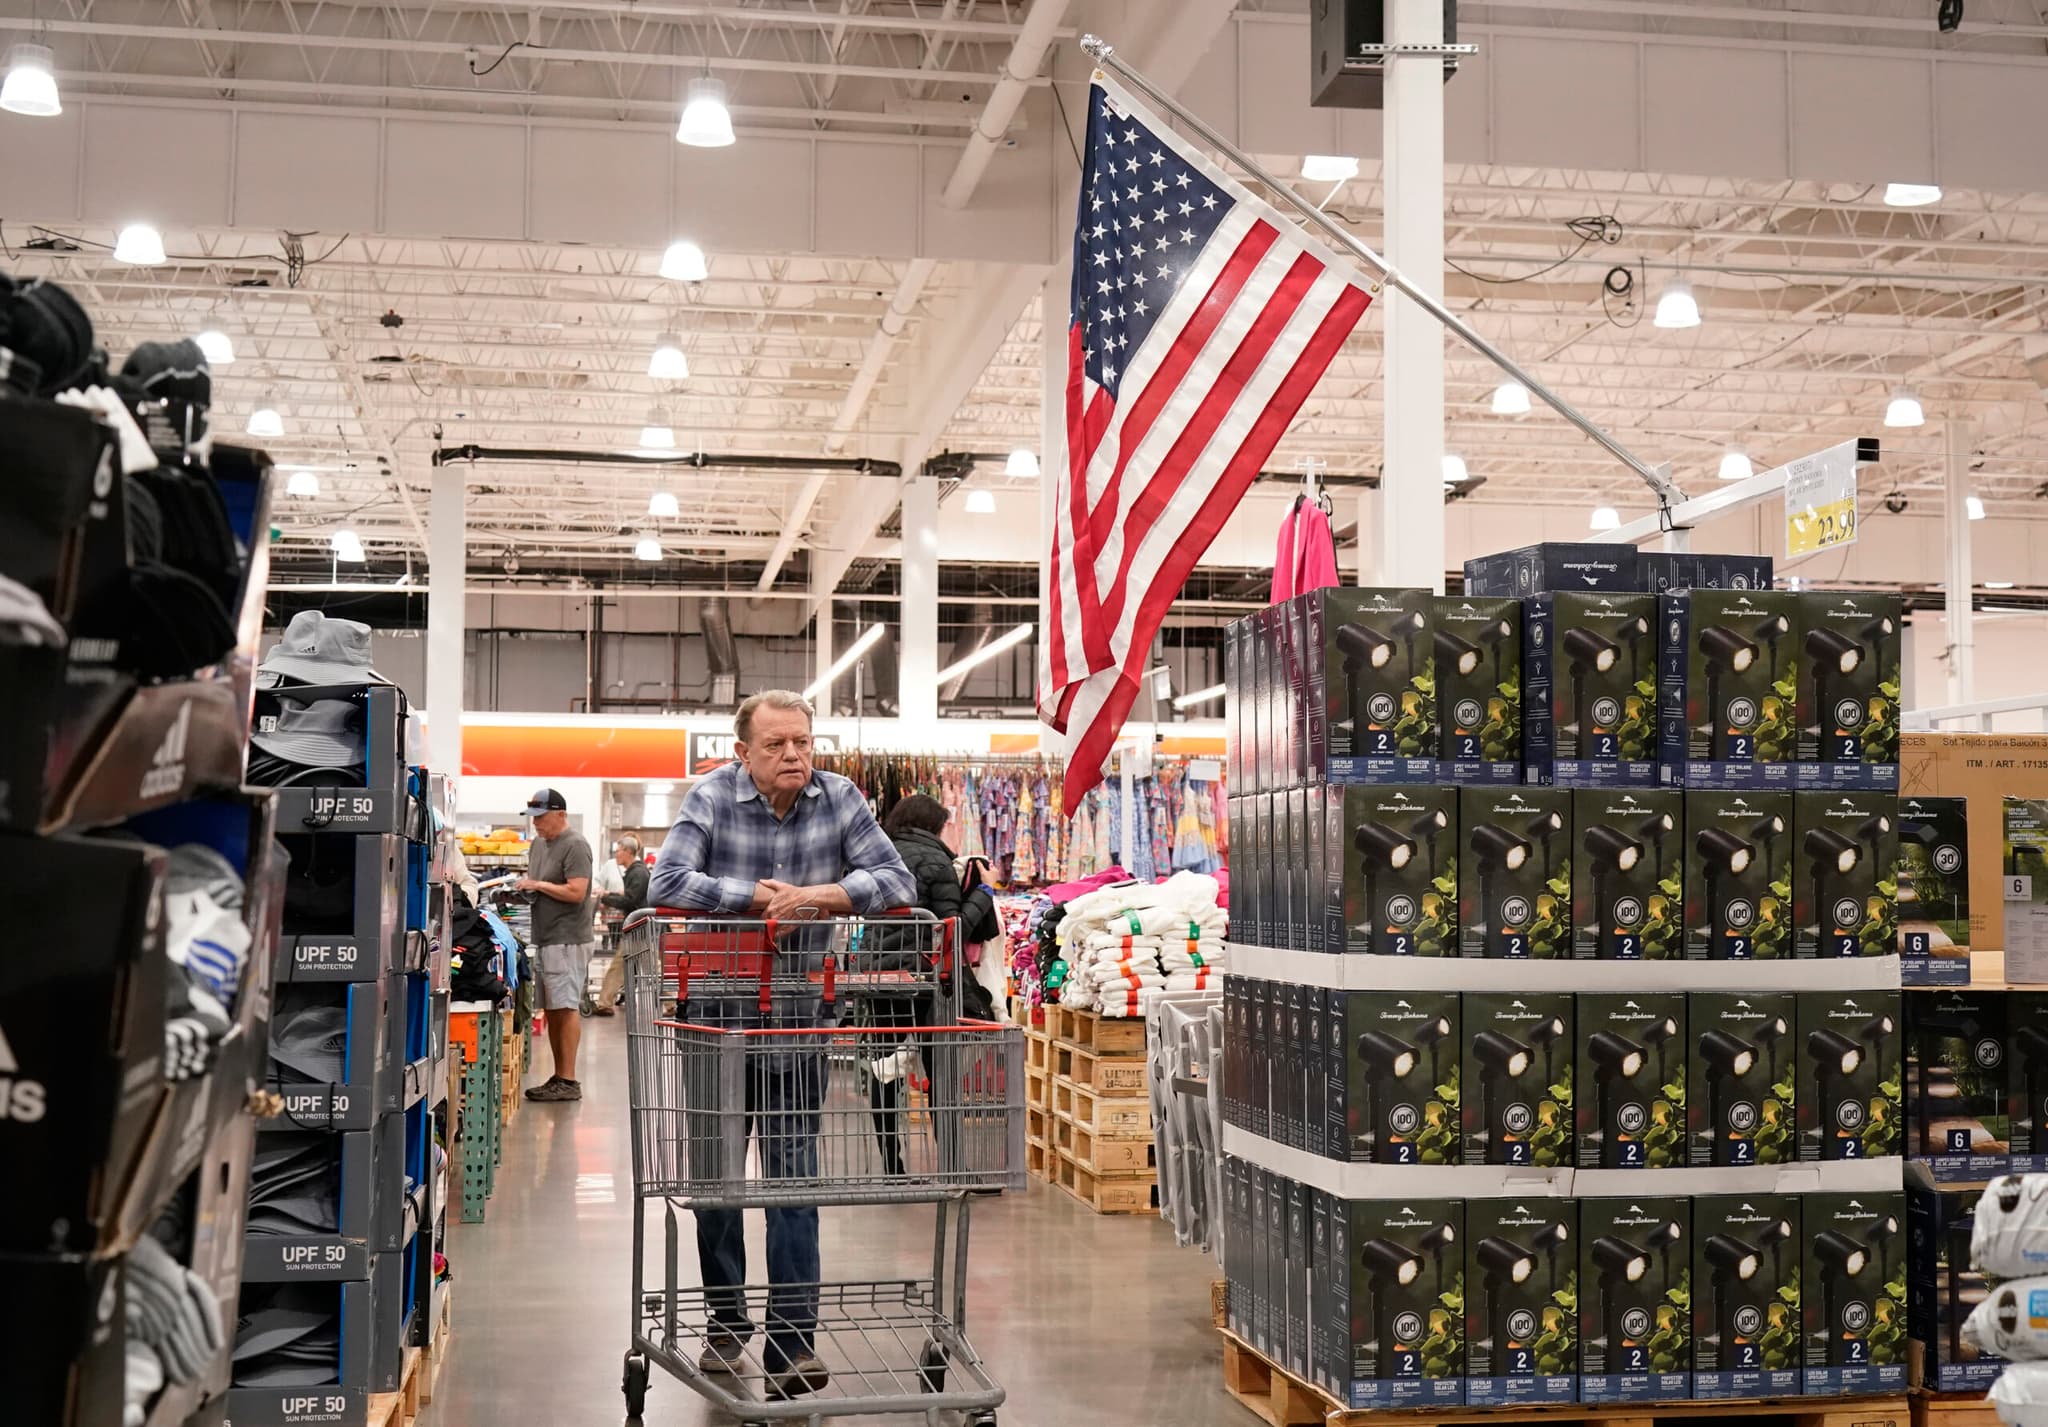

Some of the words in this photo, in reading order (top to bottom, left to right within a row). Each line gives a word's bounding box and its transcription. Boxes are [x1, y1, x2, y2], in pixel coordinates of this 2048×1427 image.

[1375, 703, 1389, 713] 100
[1461, 709, 1475, 719] 100
[1599, 707, 1613, 717] 100
[1735, 707, 1749, 717] 100
[1842, 709, 1856, 719] 100
[1378, 734, 1386, 749] 2
[1464, 739, 1472, 753] 2
[1602, 738, 1610, 752] 2
[1737, 739, 1745, 754] 2
[1845, 740, 1853, 754] 2
[1900, 737, 1926, 746] ECES
[1989, 739, 2008, 748] para
[311, 798, 346, 813] UPF
[353, 798, 373, 813] 50
[1941, 854, 1954, 864] 30
[2014, 880, 2022, 894] 6
[1394, 905, 1408, 915] 100
[1509, 906, 1523, 916] 100
[1621, 907, 1635, 917] 100
[1733, 909, 1747, 919] 100
[1840, 908, 1854, 918] 100
[1397, 937, 1405, 952] 2
[1511, 939, 1520, 953] 2
[1624, 939, 1632, 953] 2
[1735, 940, 1744, 955] 2
[1843, 939, 1851, 954] 2
[1913, 936, 1921, 950] 6
[295, 946, 331, 962] UPF
[337, 946, 357, 962] 50
[1982, 1048, 1995, 1059] 30
[286, 1096, 322, 1111] UPF
[1397, 1114, 1411, 1124] 100
[1511, 1113, 1525, 1123] 100
[1625, 1113, 1639, 1123] 100
[1736, 1111, 1750, 1121] 100
[1843, 1110, 1857, 1120] 100
[1955, 1132, 1964, 1148] 6
[1400, 1147, 1408, 1161] 2
[1513, 1145, 1522, 1160] 2
[1628, 1145, 1636, 1160] 2
[1738, 1143, 1746, 1158] 2
[1846, 1141, 1854, 1156] 2
[283, 1246, 319, 1262] UPF
[326, 1246, 345, 1261] 50
[1629, 1318, 1643, 1328] 100
[1741, 1316, 1755, 1326] 100
[1849, 1311, 1863, 1321] 100
[1401, 1322, 1415, 1332] 100
[1515, 1320, 1529, 1330] 100
[1632, 1350, 1640, 1365] 2
[1744, 1348, 1752, 1362] 2
[1852, 1343, 1860, 1358] 2
[1404, 1355, 1413, 1370] 2
[1518, 1352, 1526, 1368] 2
[282, 1397, 319, 1413] UPF
[325, 1396, 345, 1412] 50
